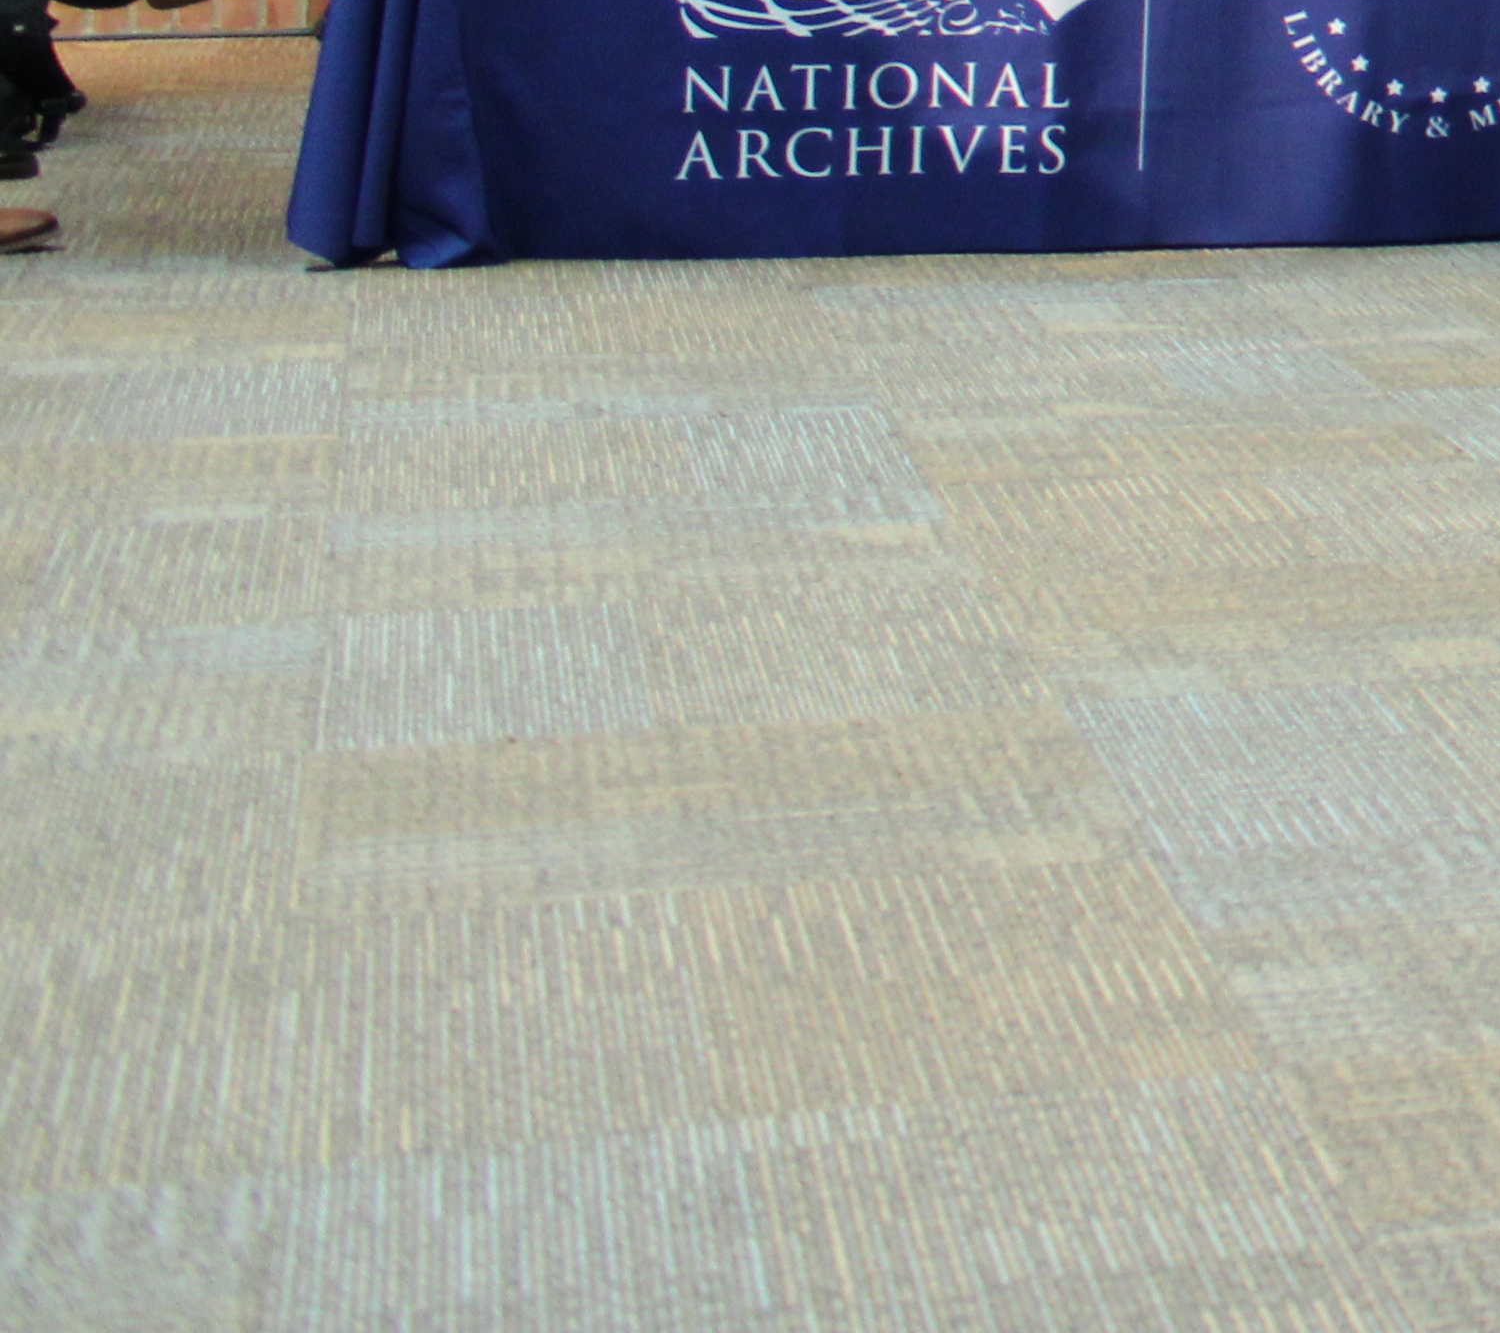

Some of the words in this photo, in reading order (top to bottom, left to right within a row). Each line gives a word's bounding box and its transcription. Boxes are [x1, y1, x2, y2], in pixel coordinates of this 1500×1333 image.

[685, 61, 1069, 112] NATIONAL
[1282, 9, 1410, 136] LIBRARY
[1425, 115, 1450, 139] &
[675, 122, 1065, 180] ARCHIVES
